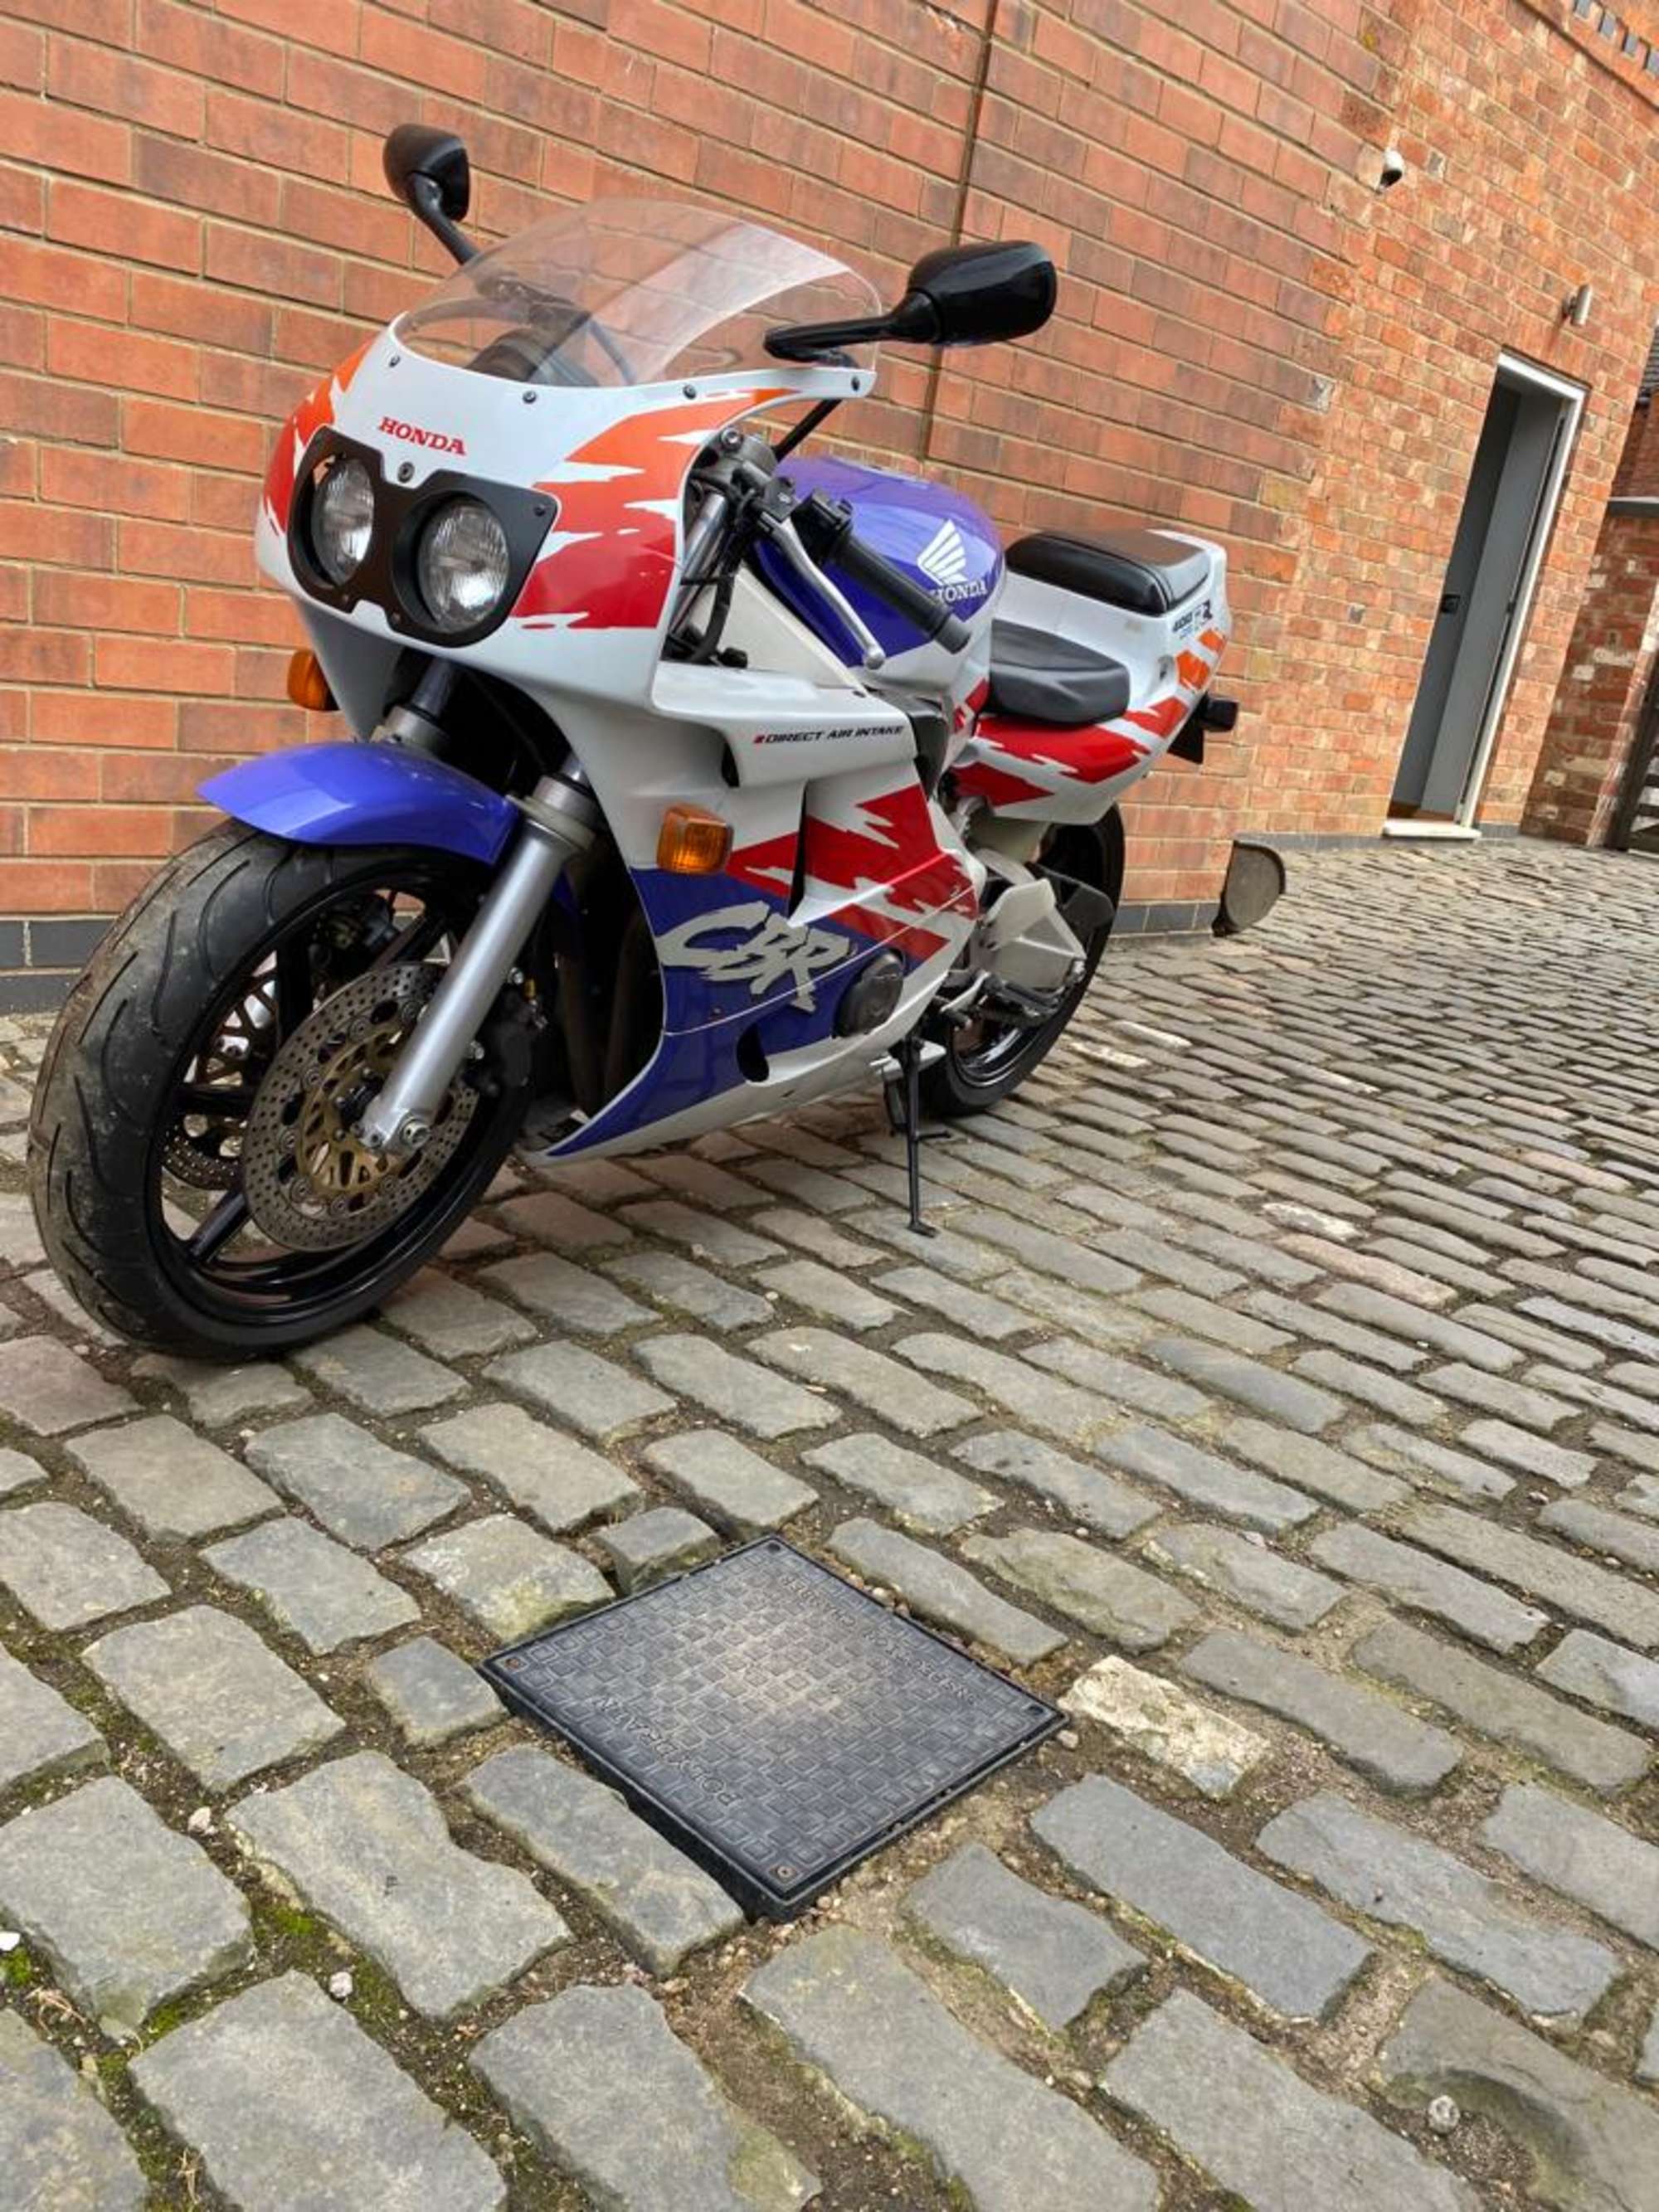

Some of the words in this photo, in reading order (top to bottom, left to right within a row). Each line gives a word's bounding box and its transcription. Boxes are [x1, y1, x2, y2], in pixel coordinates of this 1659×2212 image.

[379, 416, 465, 456] HONDA
[765, 731, 823, 743] DIRECT
[827, 728, 854, 740] AIR
[855, 725, 904, 737] INTAKE
[655, 900, 850, 1014] CBR
